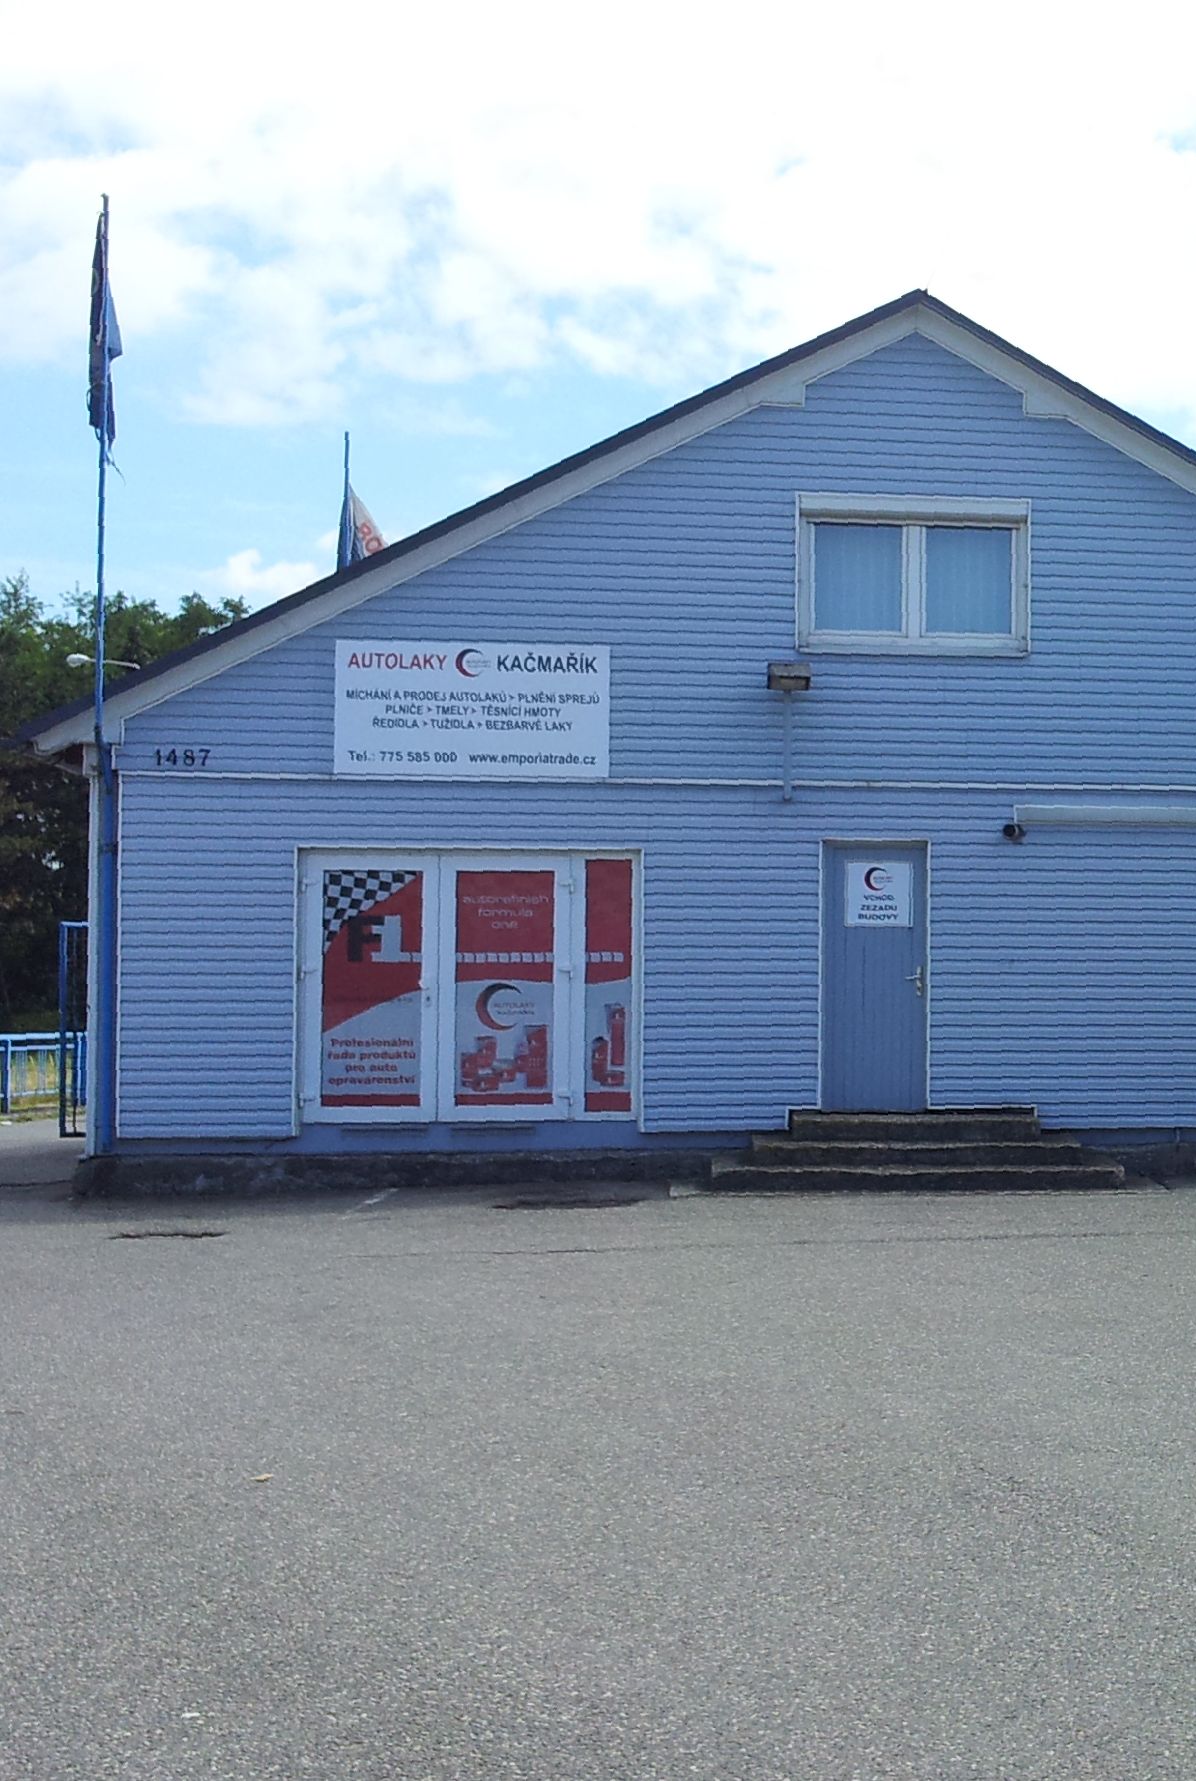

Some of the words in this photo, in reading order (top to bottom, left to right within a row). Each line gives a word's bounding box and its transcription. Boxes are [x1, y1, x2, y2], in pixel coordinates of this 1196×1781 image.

[347, 652, 447, 671] AUTOLAKY
[496, 652, 598, 674] KAČMAŘÍK
[346, 688, 391, 701] MÍCHÁNÍ
[393, 690, 402, 701] A
[403, 691, 447, 702] PRODEJ
[449, 690, 507, 703] AUTOLAKŮ
[558, 692, 600, 705] SPREJŮ
[435, 705, 470, 716] TMELY
[523, 707, 561, 718] HMOTY
[430, 718, 475, 730] TUŽIDLA
[485, 719, 542, 731] BEZBARVÉ
[544, 721, 573, 732] LAKY
[155, 748, 211, 767] 1487
[380, 751, 403, 762] 775
[407, 751, 431, 763] 585
[434, 752, 458, 763] 000
[469, 752, 597, 766] www.emporiatrade.cz
